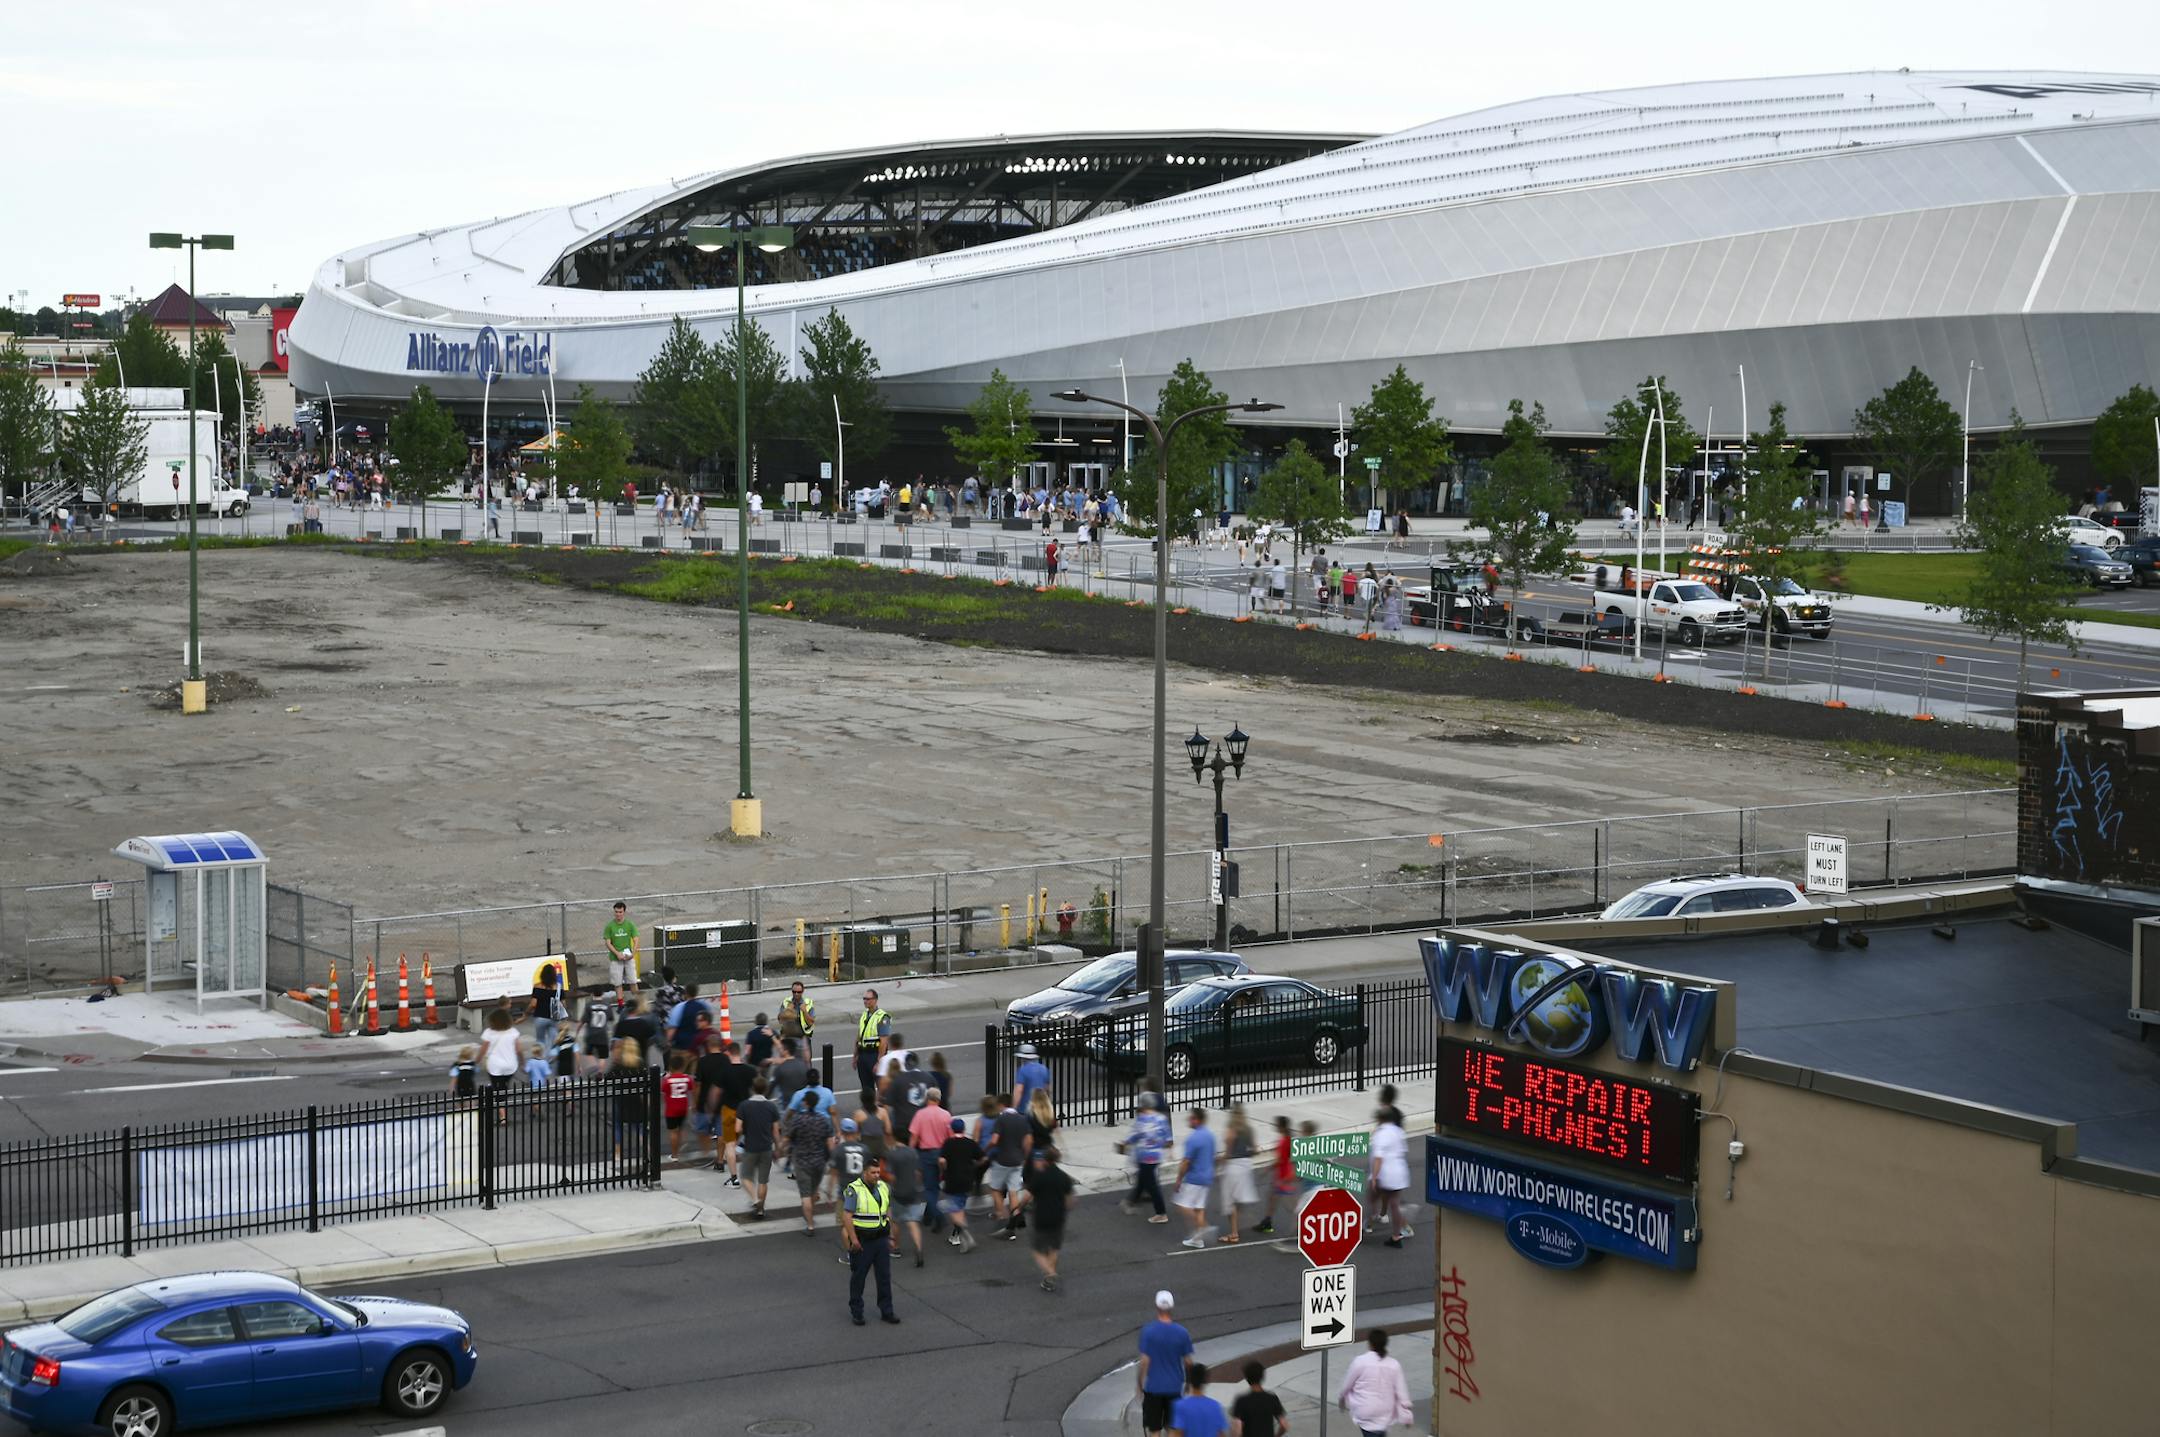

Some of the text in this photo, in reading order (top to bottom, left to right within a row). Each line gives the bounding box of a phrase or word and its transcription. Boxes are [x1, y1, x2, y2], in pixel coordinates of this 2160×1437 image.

[407, 332, 551, 374] Allianz Field
[1810, 842, 1843, 854] LEFT LANE
[1816, 858, 1837, 871] MUST
[1810, 874, 1843, 887] TURN LEFT
[1464, 1049, 1652, 1125] WE REPAIR
[1292, 1135, 1364, 1157] Snelling Ave
[1346, 1143, 1368, 1155] 450 N
[1326, 1163, 1345, 1184] Tree
[1348, 1169, 1360, 1181] Ave
[1436, 1154, 1669, 1255] WWW.WORLDOFWIRELESS.COM
[1302, 1210, 1358, 1245] STOP
[1312, 1273, 1346, 1293] ONE
[1311, 1294, 1347, 1314] WAY
